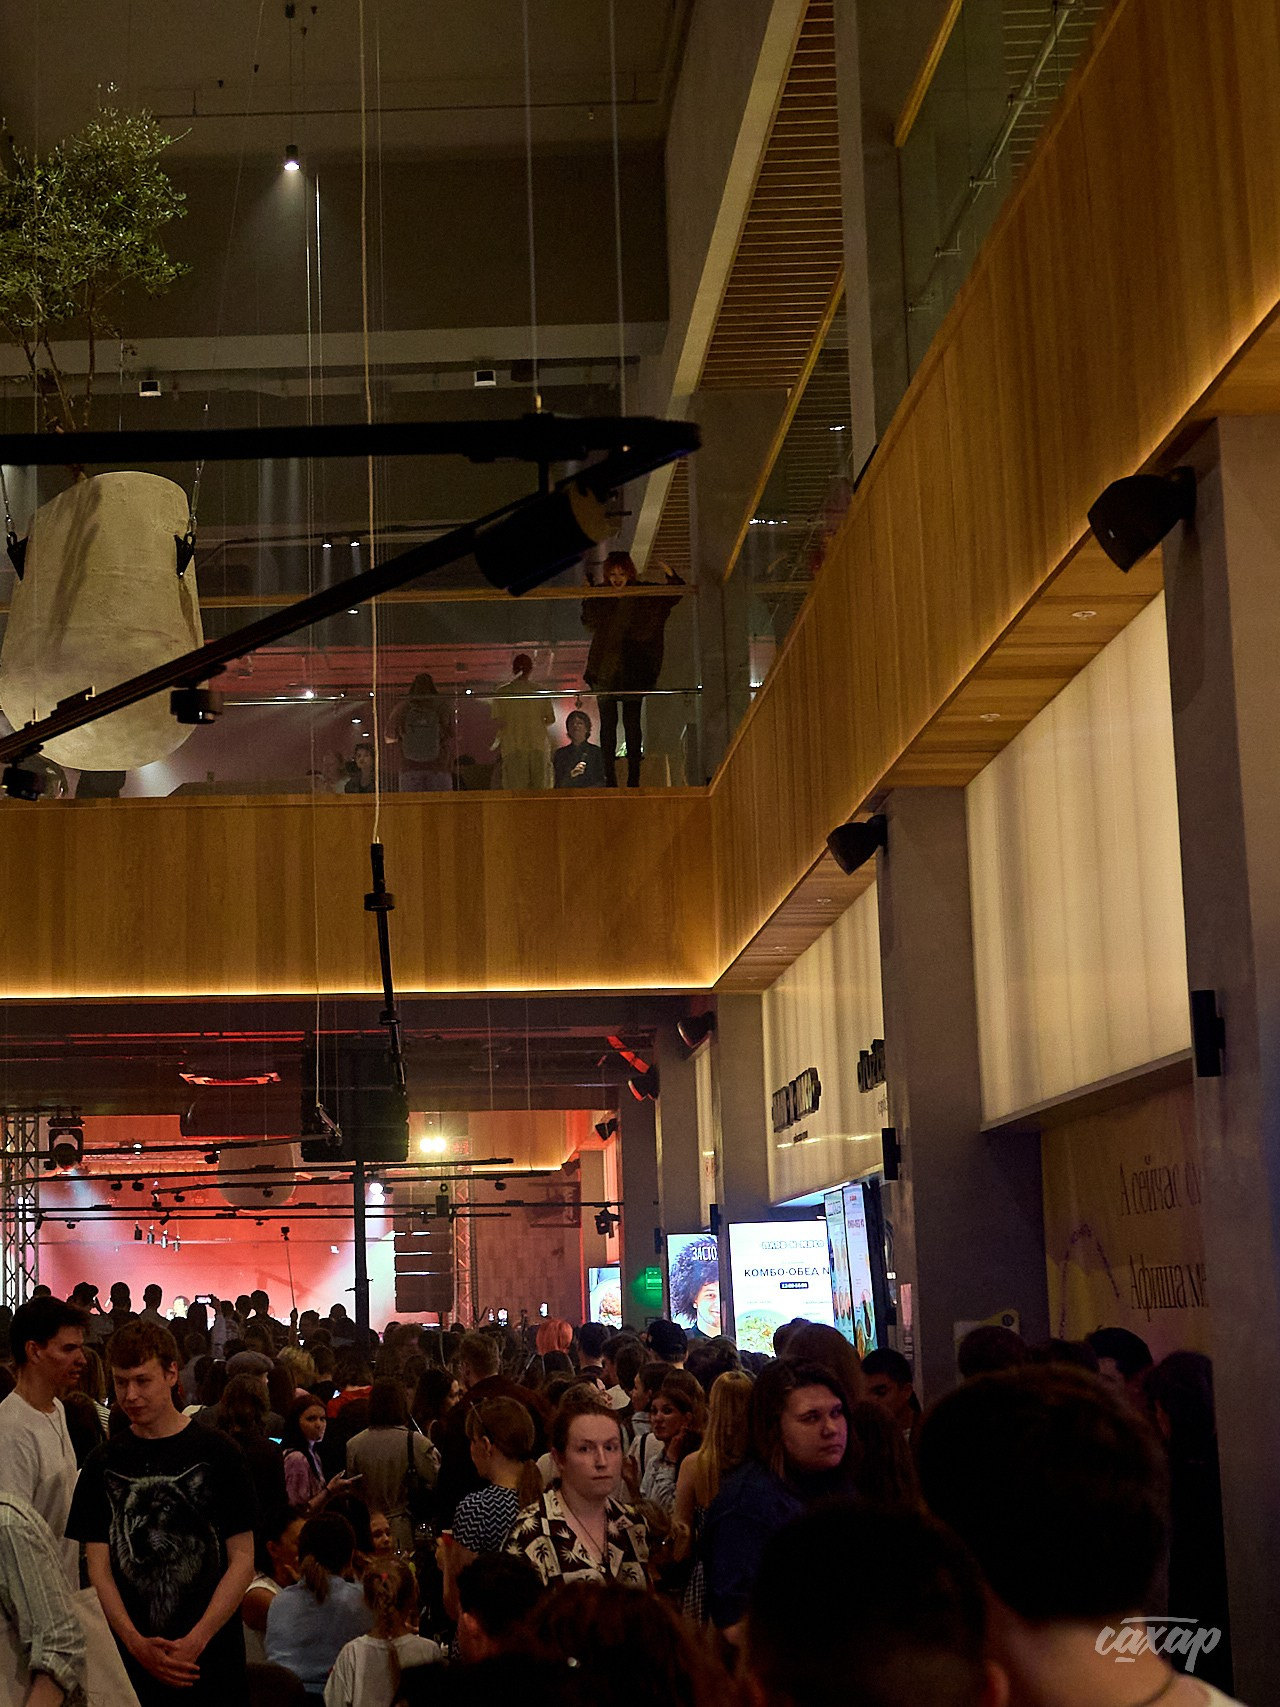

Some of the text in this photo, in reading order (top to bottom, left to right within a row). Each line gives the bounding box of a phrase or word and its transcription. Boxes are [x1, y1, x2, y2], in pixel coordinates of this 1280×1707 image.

[1132, 1155, 1183, 1214] сейчас
[691, 1246, 718, 1260] ЗАСТО
[744, 1267, 819, 1277] КОМБО-ОБЕД
[1129, 1253, 1188, 1322] Афиша
